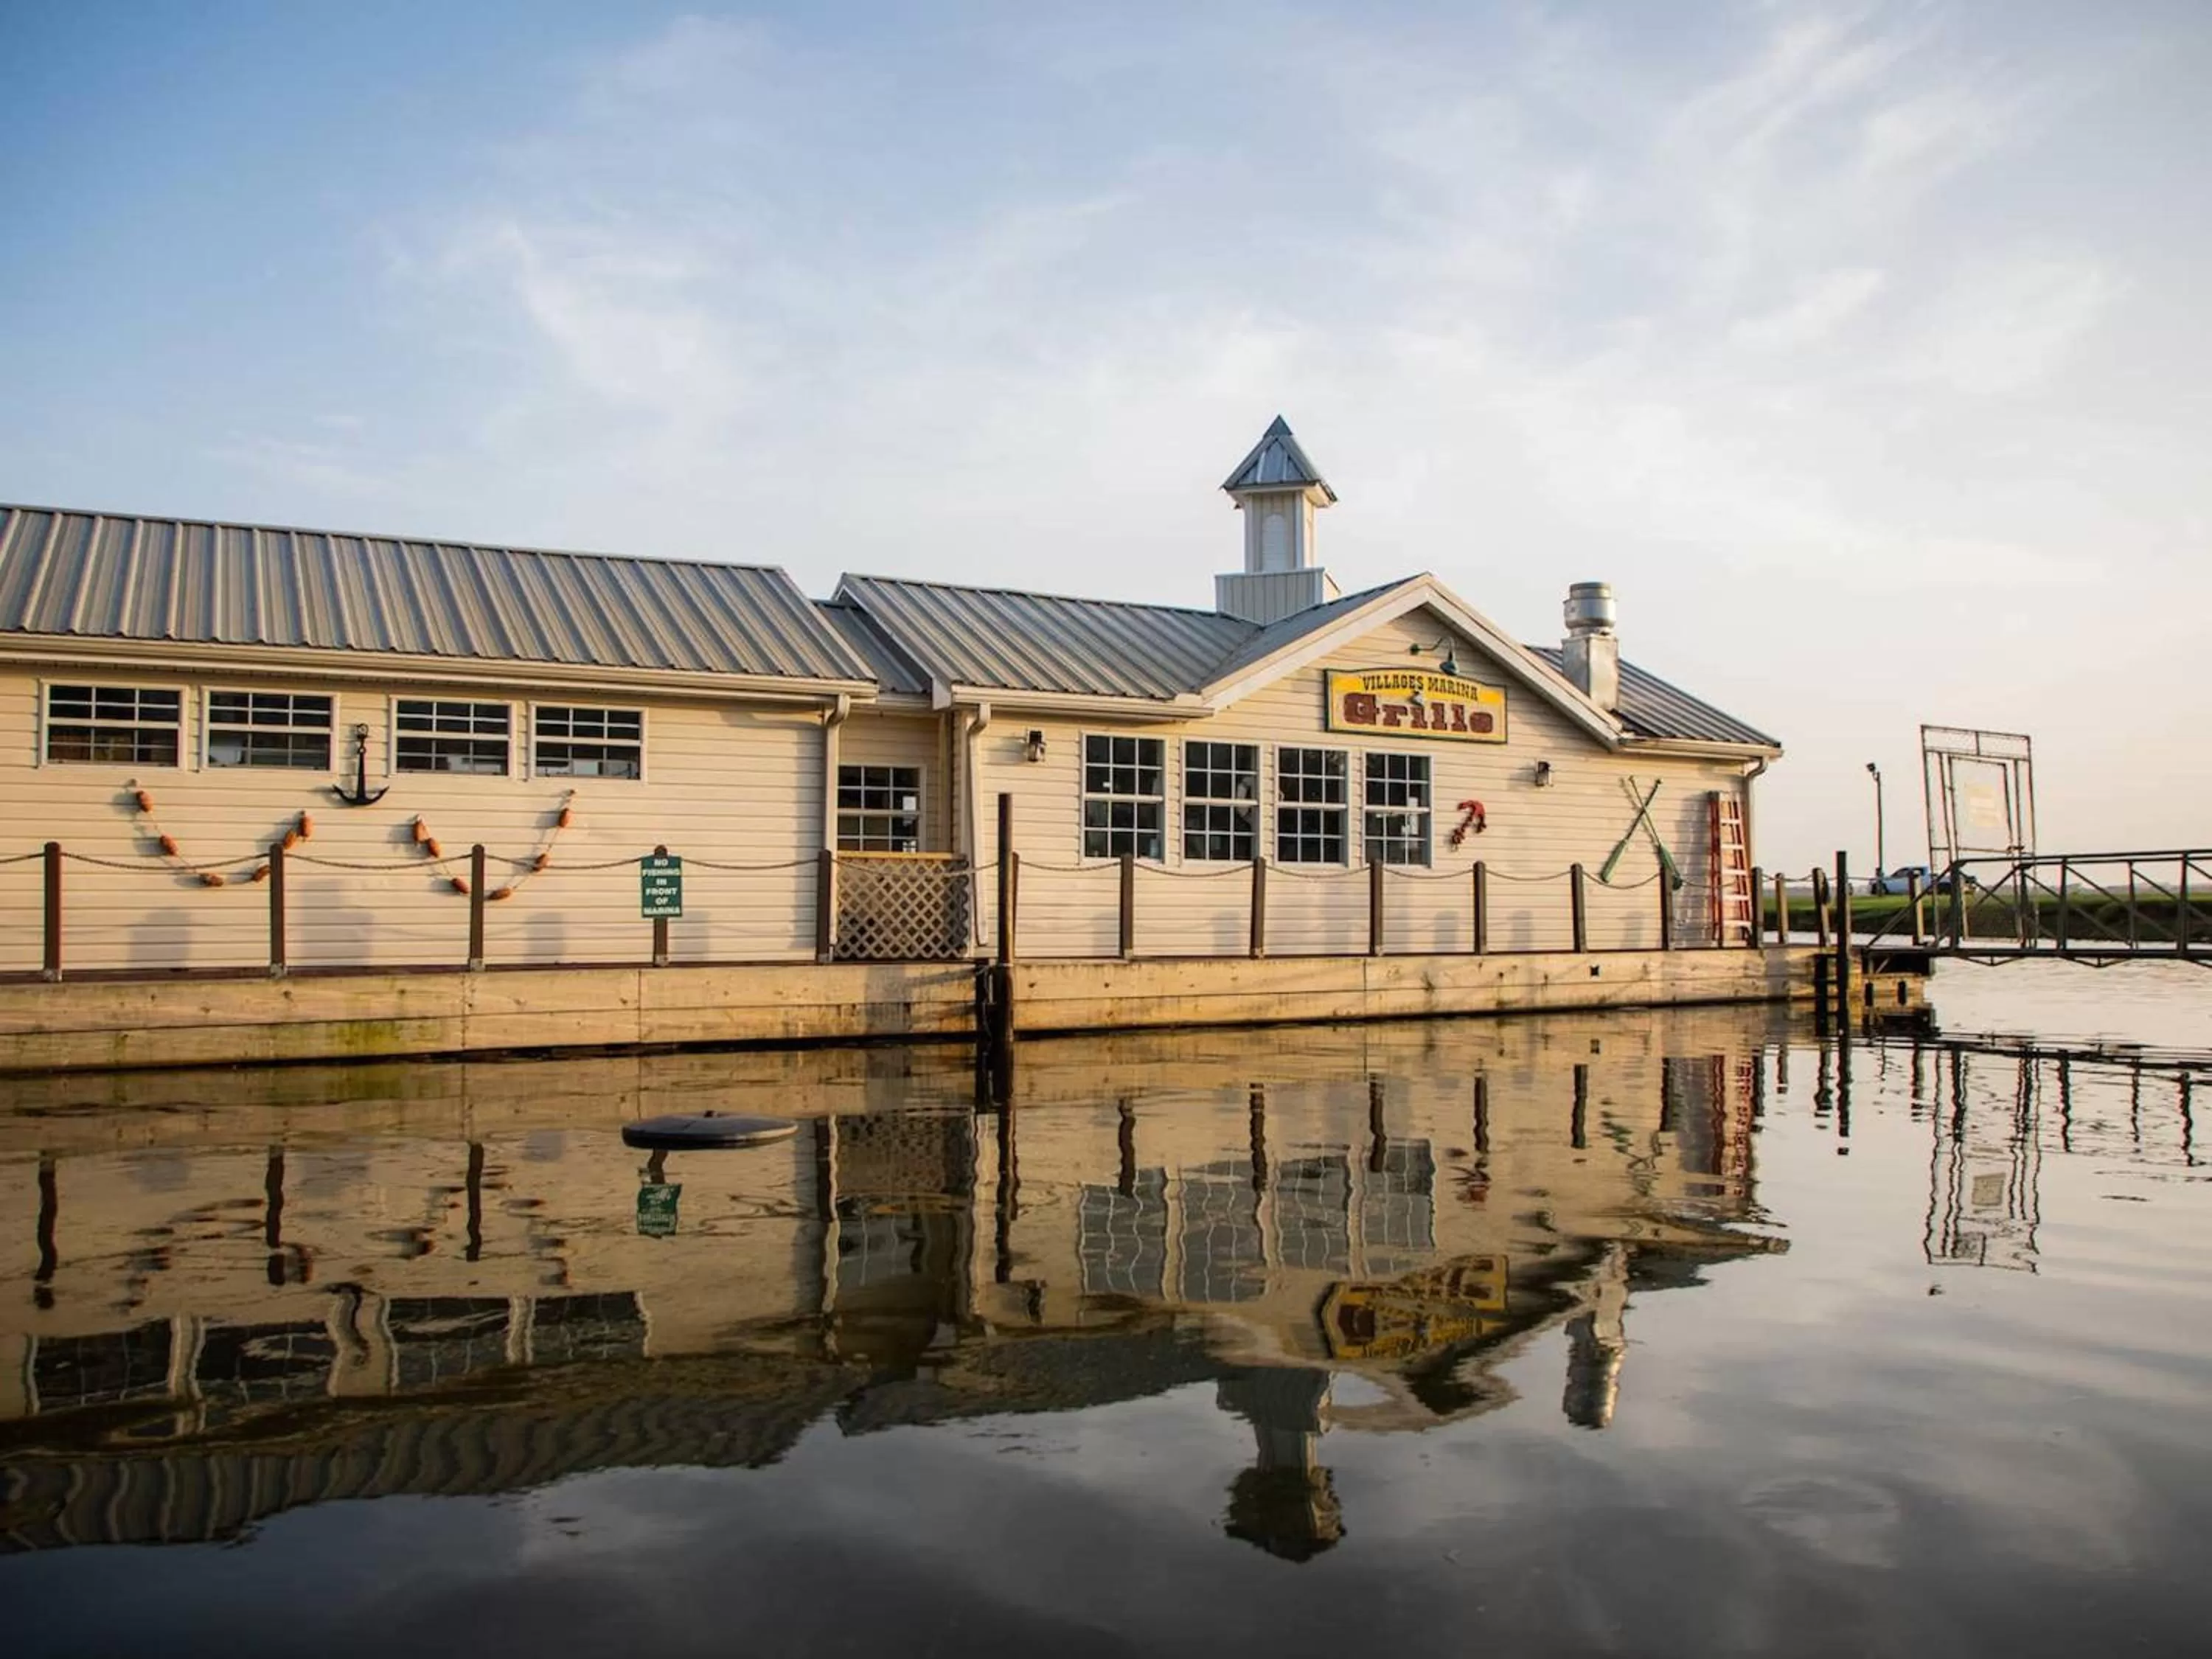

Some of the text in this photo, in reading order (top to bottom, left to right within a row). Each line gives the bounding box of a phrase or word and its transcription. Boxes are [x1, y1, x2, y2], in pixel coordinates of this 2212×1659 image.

[1362, 674, 1478, 701] VILLAGES MARINA
[654, 858, 669, 867] NO
[646, 888, 678, 896] FRONT
[655, 897, 669, 905] OF
